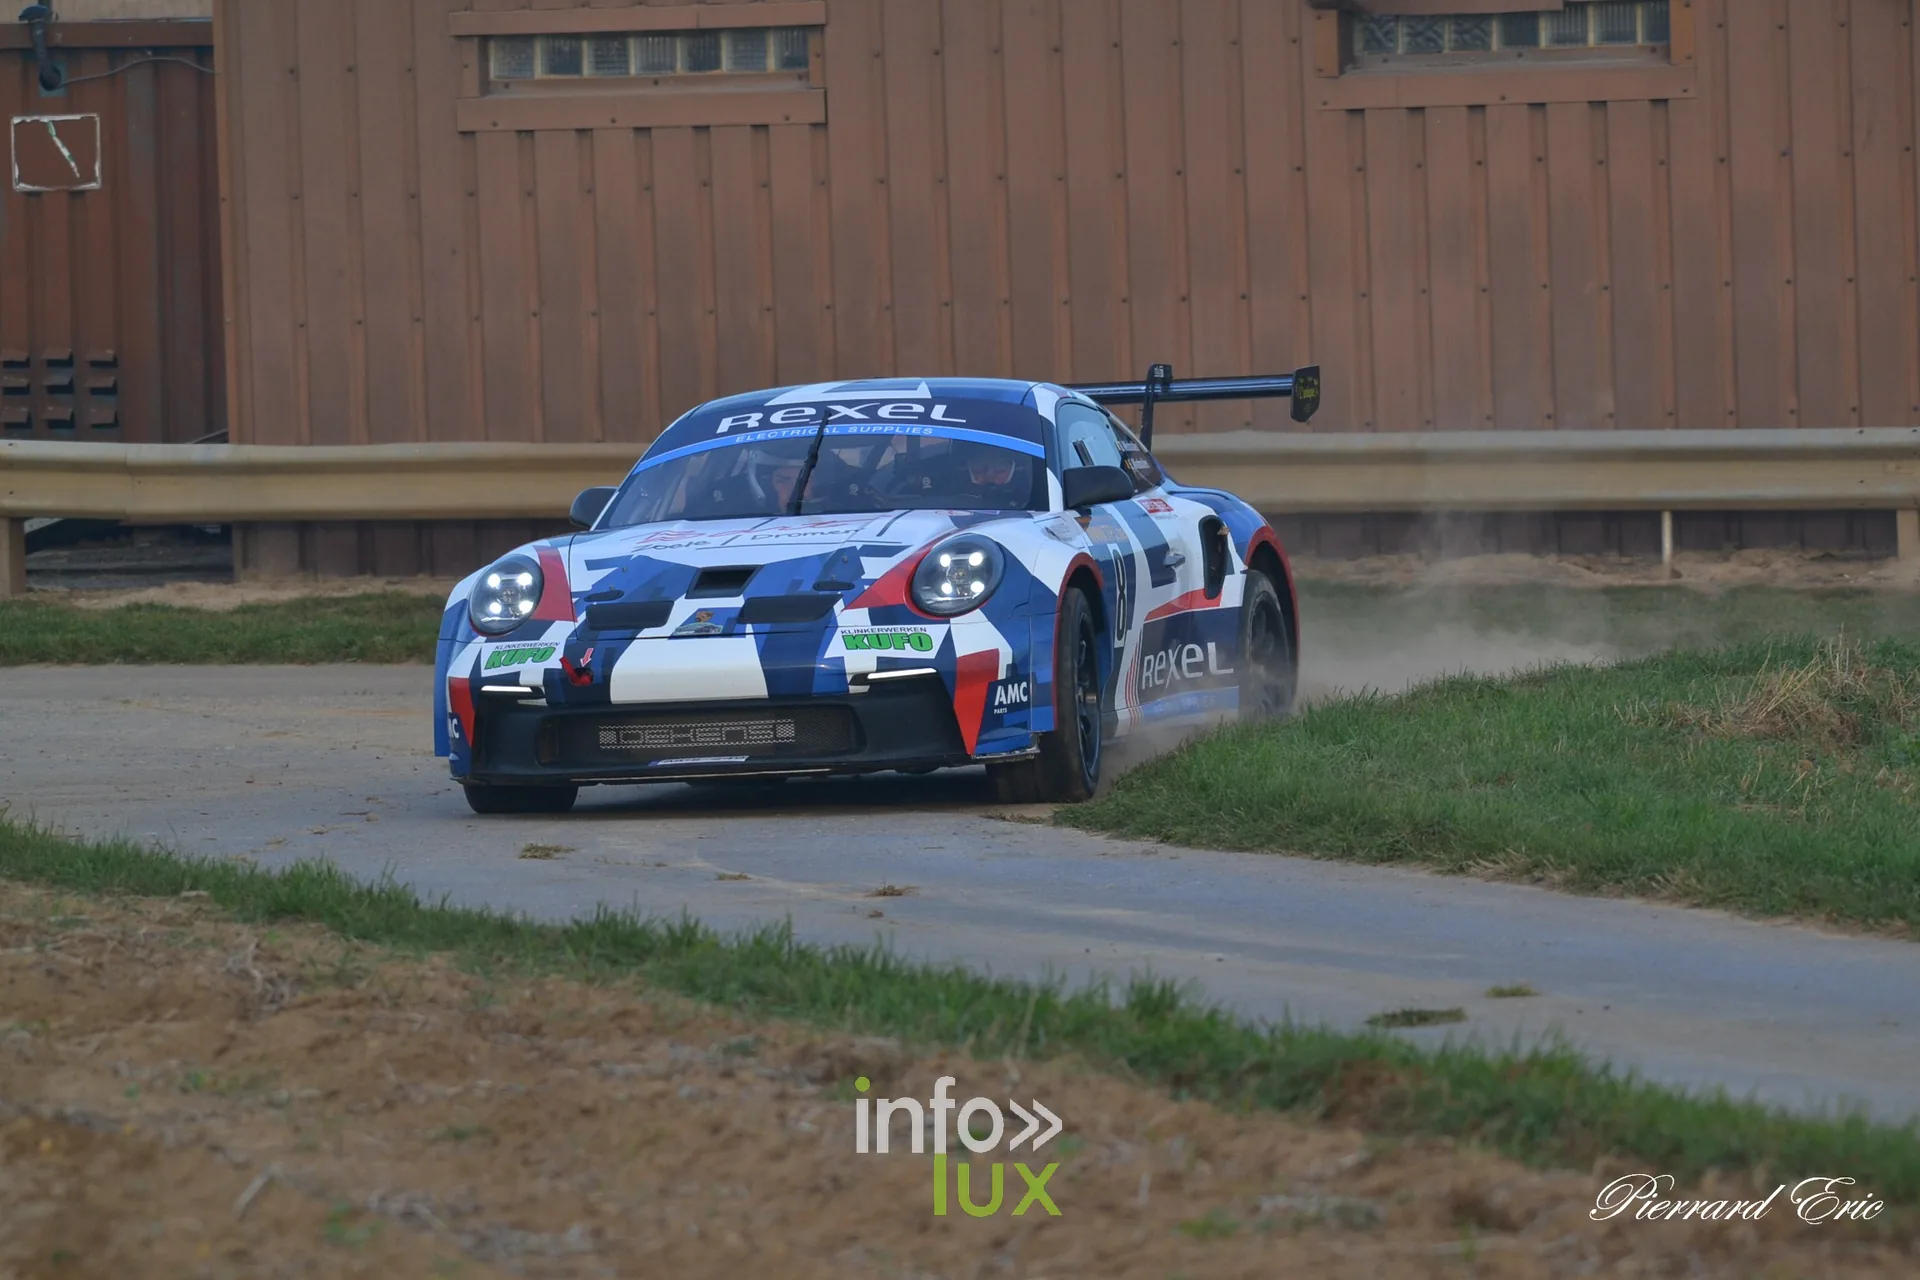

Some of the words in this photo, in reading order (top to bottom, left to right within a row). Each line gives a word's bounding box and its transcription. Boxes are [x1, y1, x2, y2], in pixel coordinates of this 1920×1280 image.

[736, 426, 840, 443] ELECTRICAL
[848, 426, 933, 435] SUPPLIES
[1113, 549, 1128, 642] 8
[841, 626, 927, 634] KLINKERWERKEN
[494, 641, 561, 650] KLINKERWERKEN
[842, 632, 933, 651] KUFO
[483, 647, 557, 670] KUFO
[994, 681, 1028, 706] AMC
